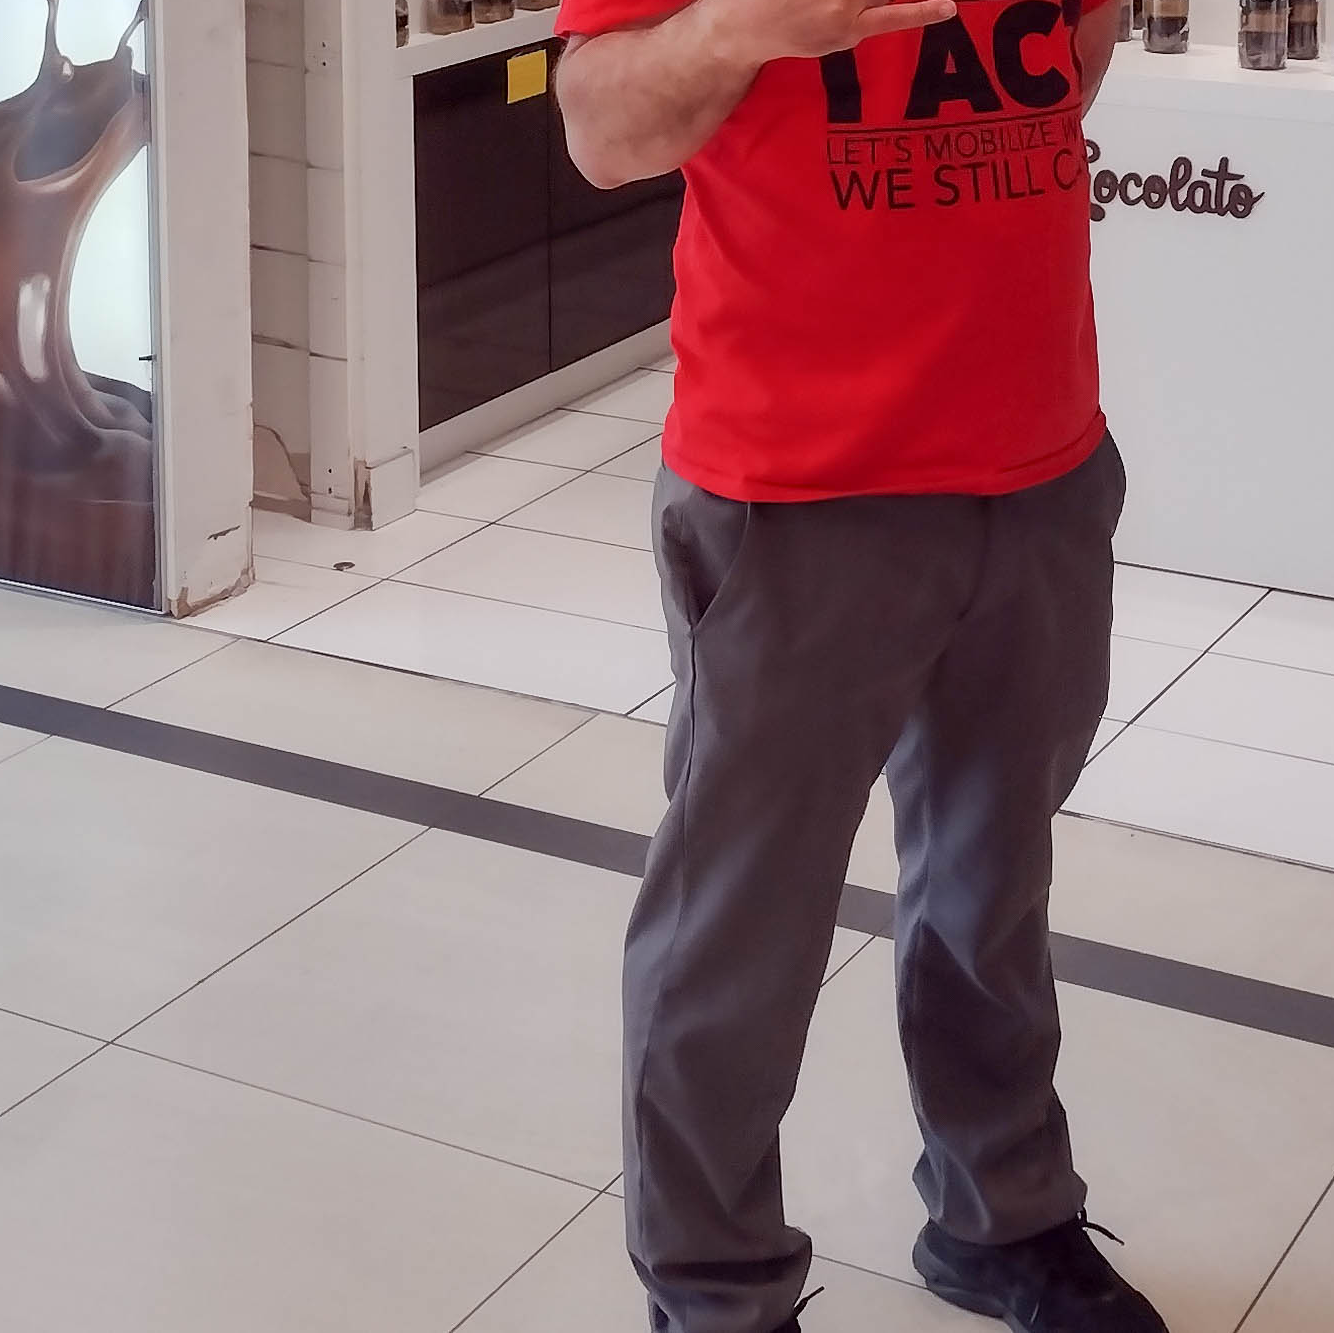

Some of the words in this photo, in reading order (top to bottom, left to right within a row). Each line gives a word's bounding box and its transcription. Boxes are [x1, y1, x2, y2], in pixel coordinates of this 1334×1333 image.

[826, 136, 912, 166] LET'S
[923, 121, 1056, 162] MOBILIZE
[830, 168, 916, 211] WE
[932, 154, 1046, 207] STILL
[1086, 139, 1266, 222] ocolato
